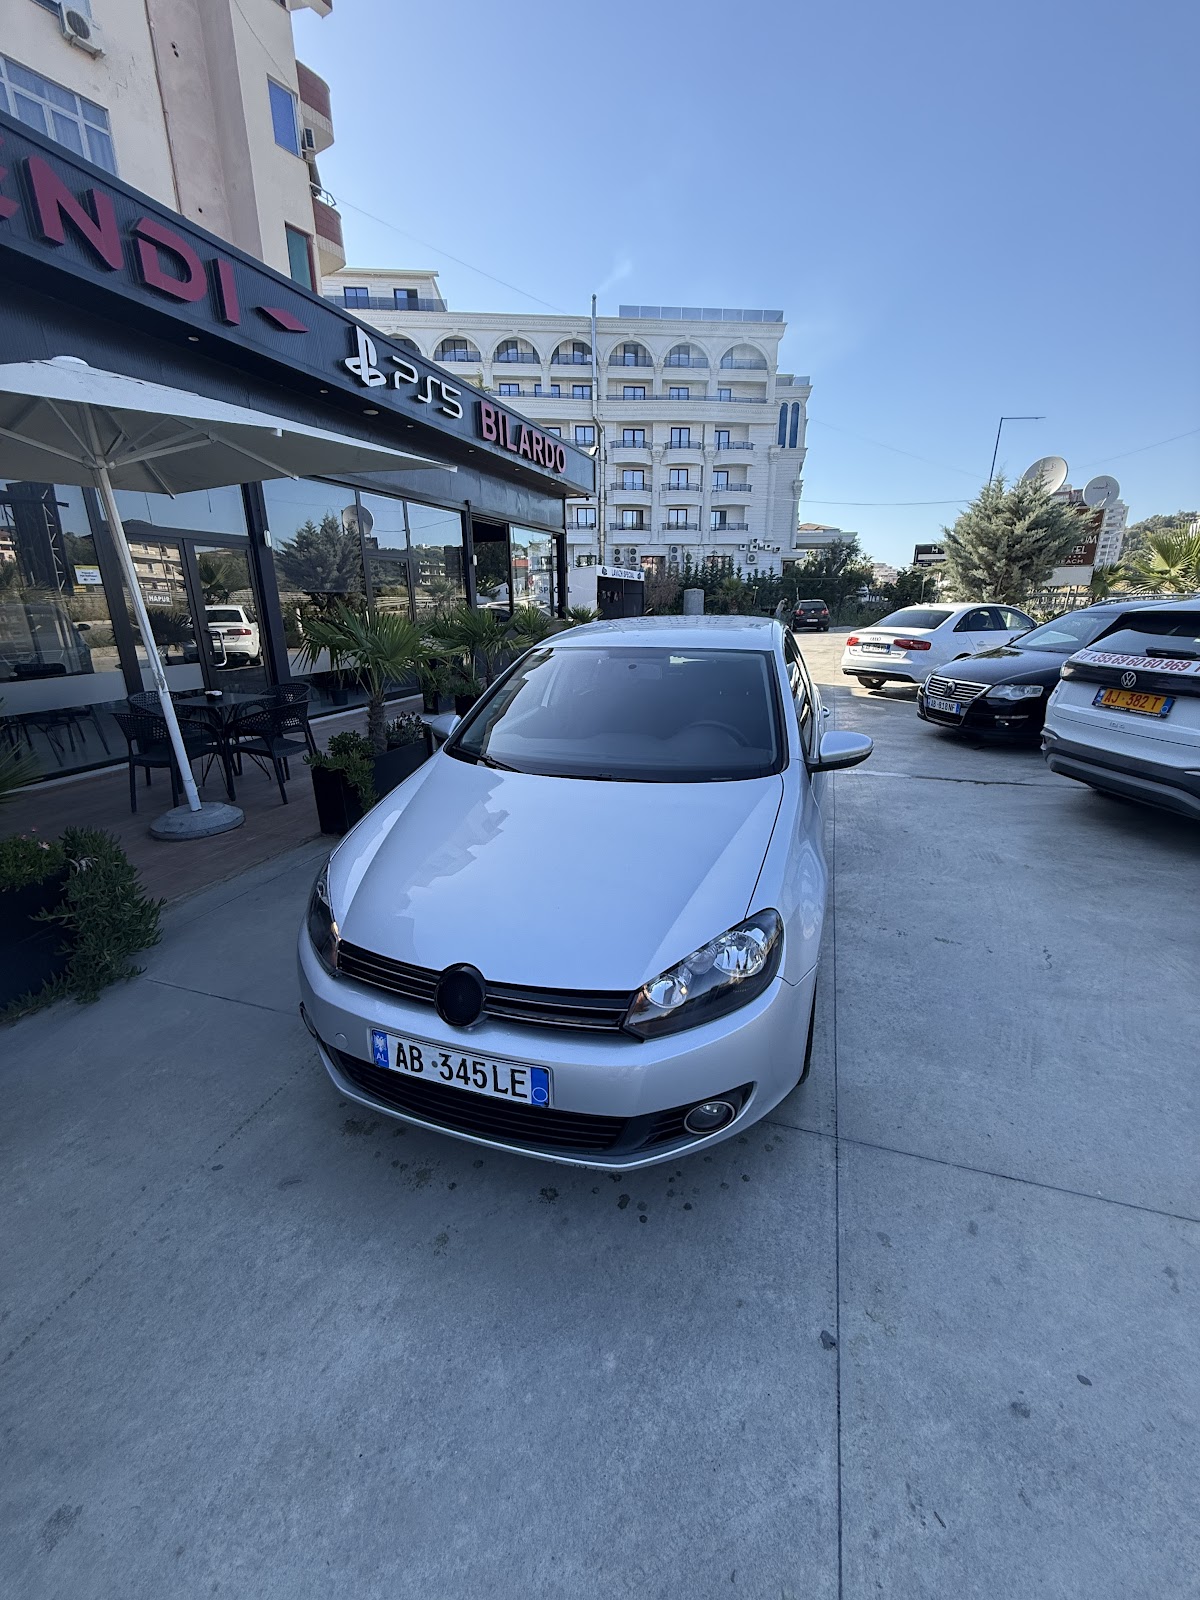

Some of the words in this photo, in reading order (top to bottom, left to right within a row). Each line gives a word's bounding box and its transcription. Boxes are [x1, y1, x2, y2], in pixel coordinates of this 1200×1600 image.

[0, 136, 240, 326] NDI
[391, 355, 464, 419] PS5
[479, 400, 567, 474] BILARDO
[1111, 654, 1127, 665] 69
[1126, 656, 1144, 667] 60
[1142, 658, 1162, 669] 60
[1160, 660, 1192, 672] 969
[1125, 693, 1150, 709] 382
[396, 1042, 423, 1073] AB
